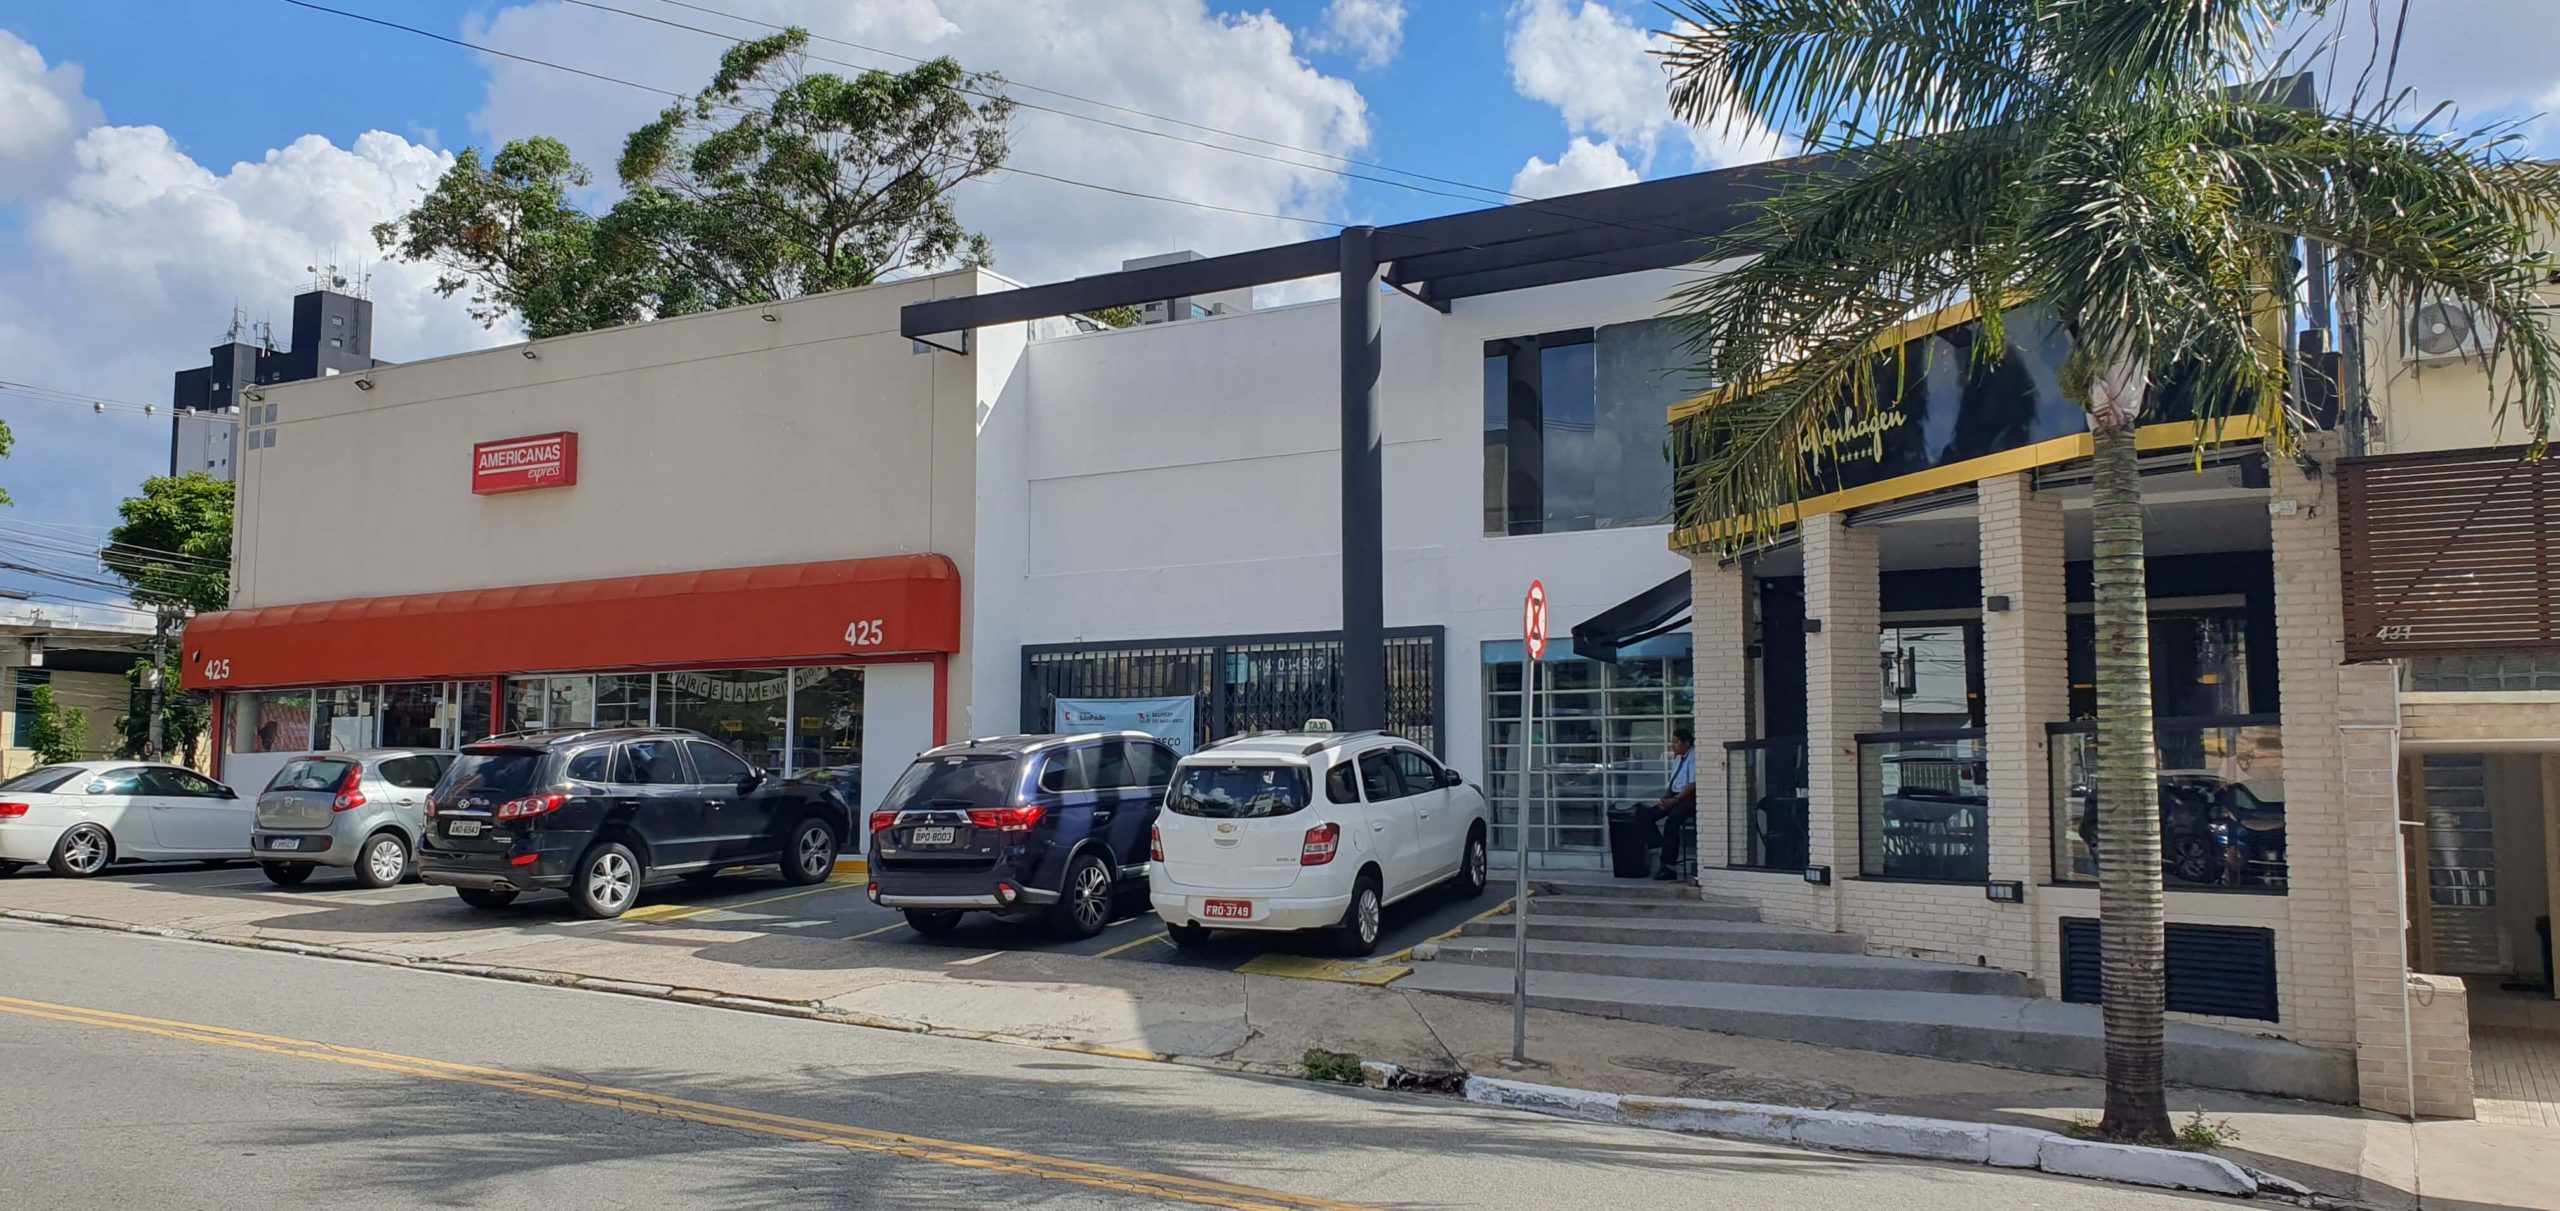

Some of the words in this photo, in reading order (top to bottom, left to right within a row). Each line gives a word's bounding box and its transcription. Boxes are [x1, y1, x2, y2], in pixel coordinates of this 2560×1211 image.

[1797, 407, 1907, 476] oenhagen
[479, 444, 560, 469] AMERICANAS
[527, 466, 560, 482] express
[844, 619, 883, 646] 425
[2376, 625, 2412, 640] 431
[204, 659, 230, 680] 425
[1307, 721, 1327, 730] TAXI
